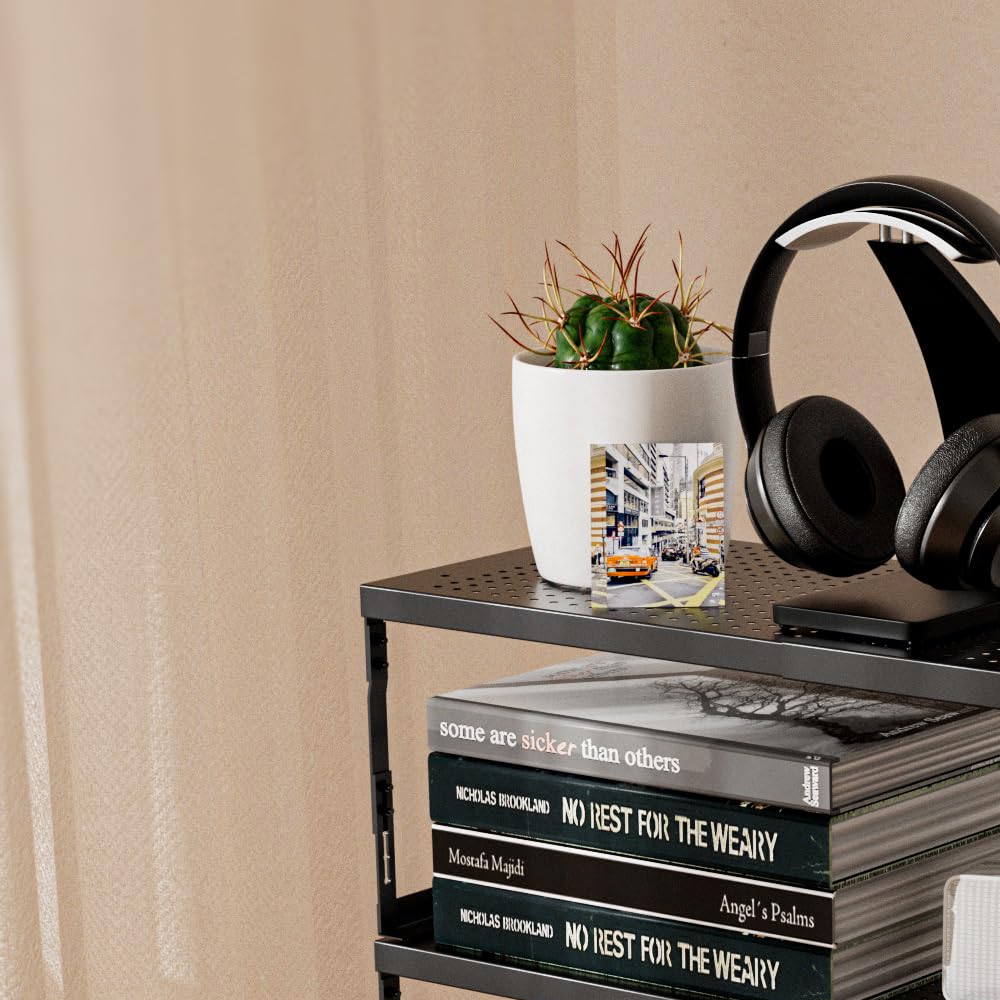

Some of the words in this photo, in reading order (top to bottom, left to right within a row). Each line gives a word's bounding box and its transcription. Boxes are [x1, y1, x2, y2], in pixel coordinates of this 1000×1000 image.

[440, 722, 485, 742] some
[490, 729, 517, 747] are
[522, 730, 577, 756] sicker
[581, 738, 620, 764] than
[625, 747, 680, 773] others
[802, 766, 811, 804] Andrew
[810, 766, 819, 807] Seaward
[456, 786, 496, 806] NICHOLAS
[499, 793, 550, 814] BROOKLAND
[562, 796, 585, 826] NO
[590, 802, 633, 834] REST
[638, 809, 670, 841] FOR
[675, 814, 708, 848] THE
[710, 821, 778, 863] WEARY
[448, 848, 489, 871] Mostafa
[492, 855, 524, 879] Majidi
[772, 902, 815, 928] Psalms
[460, 908, 500, 929] NICHOLAS
[503, 916, 553, 939] BROOKLAND
[566, 921, 588, 951] NO
[594, 927, 636, 960] REST
[641, 935, 672, 967] FOR
[677, 941, 710, 975] THE
[713, 948, 780, 990] WEARY
